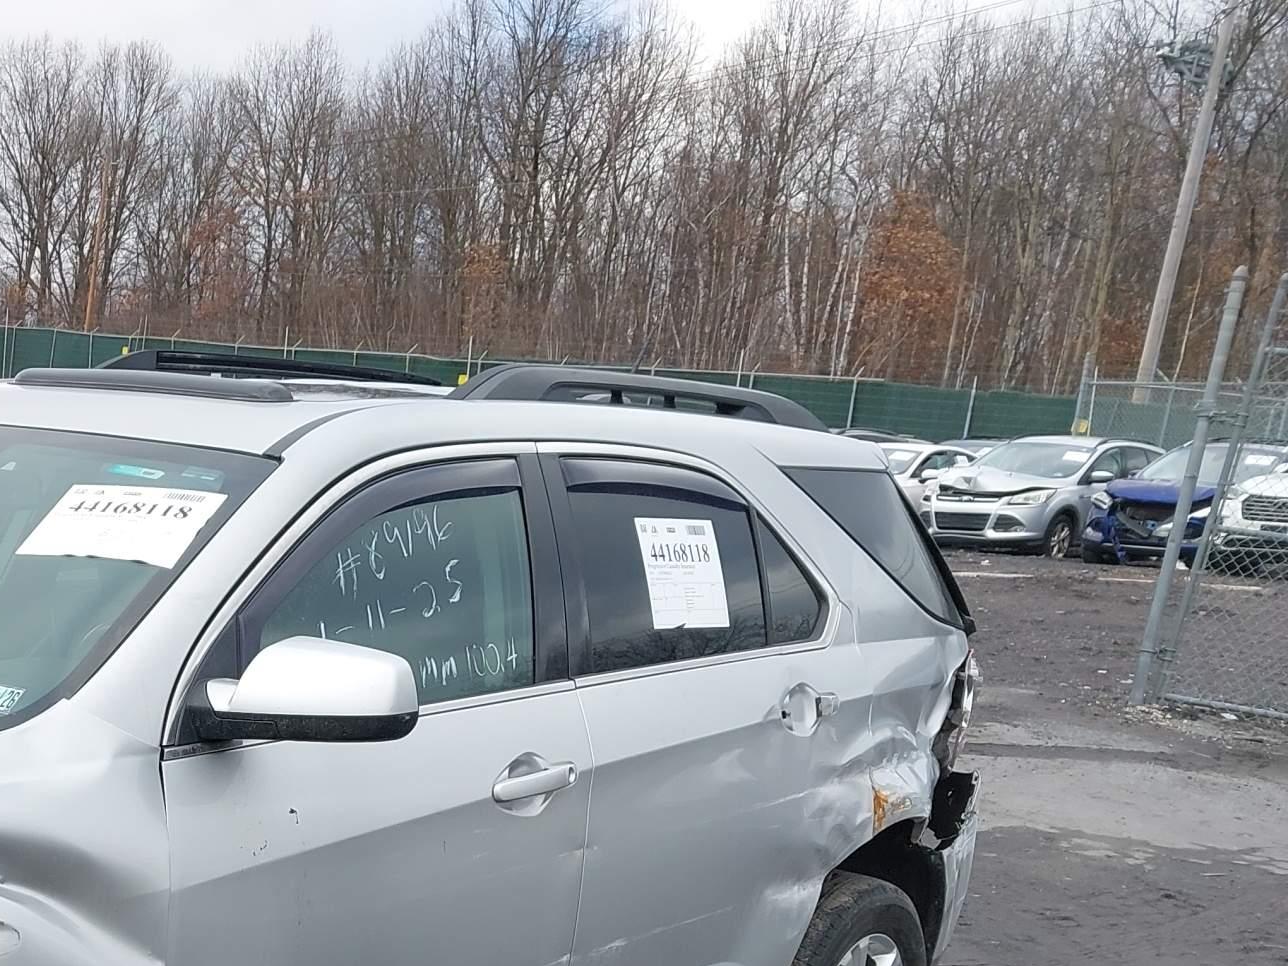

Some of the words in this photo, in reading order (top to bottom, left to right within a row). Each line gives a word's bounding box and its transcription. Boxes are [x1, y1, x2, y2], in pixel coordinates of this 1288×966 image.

[69, 500, 193, 519] 44168118
[650, 542, 711, 562] 44168118
[0, 690, 20, 710] 26
